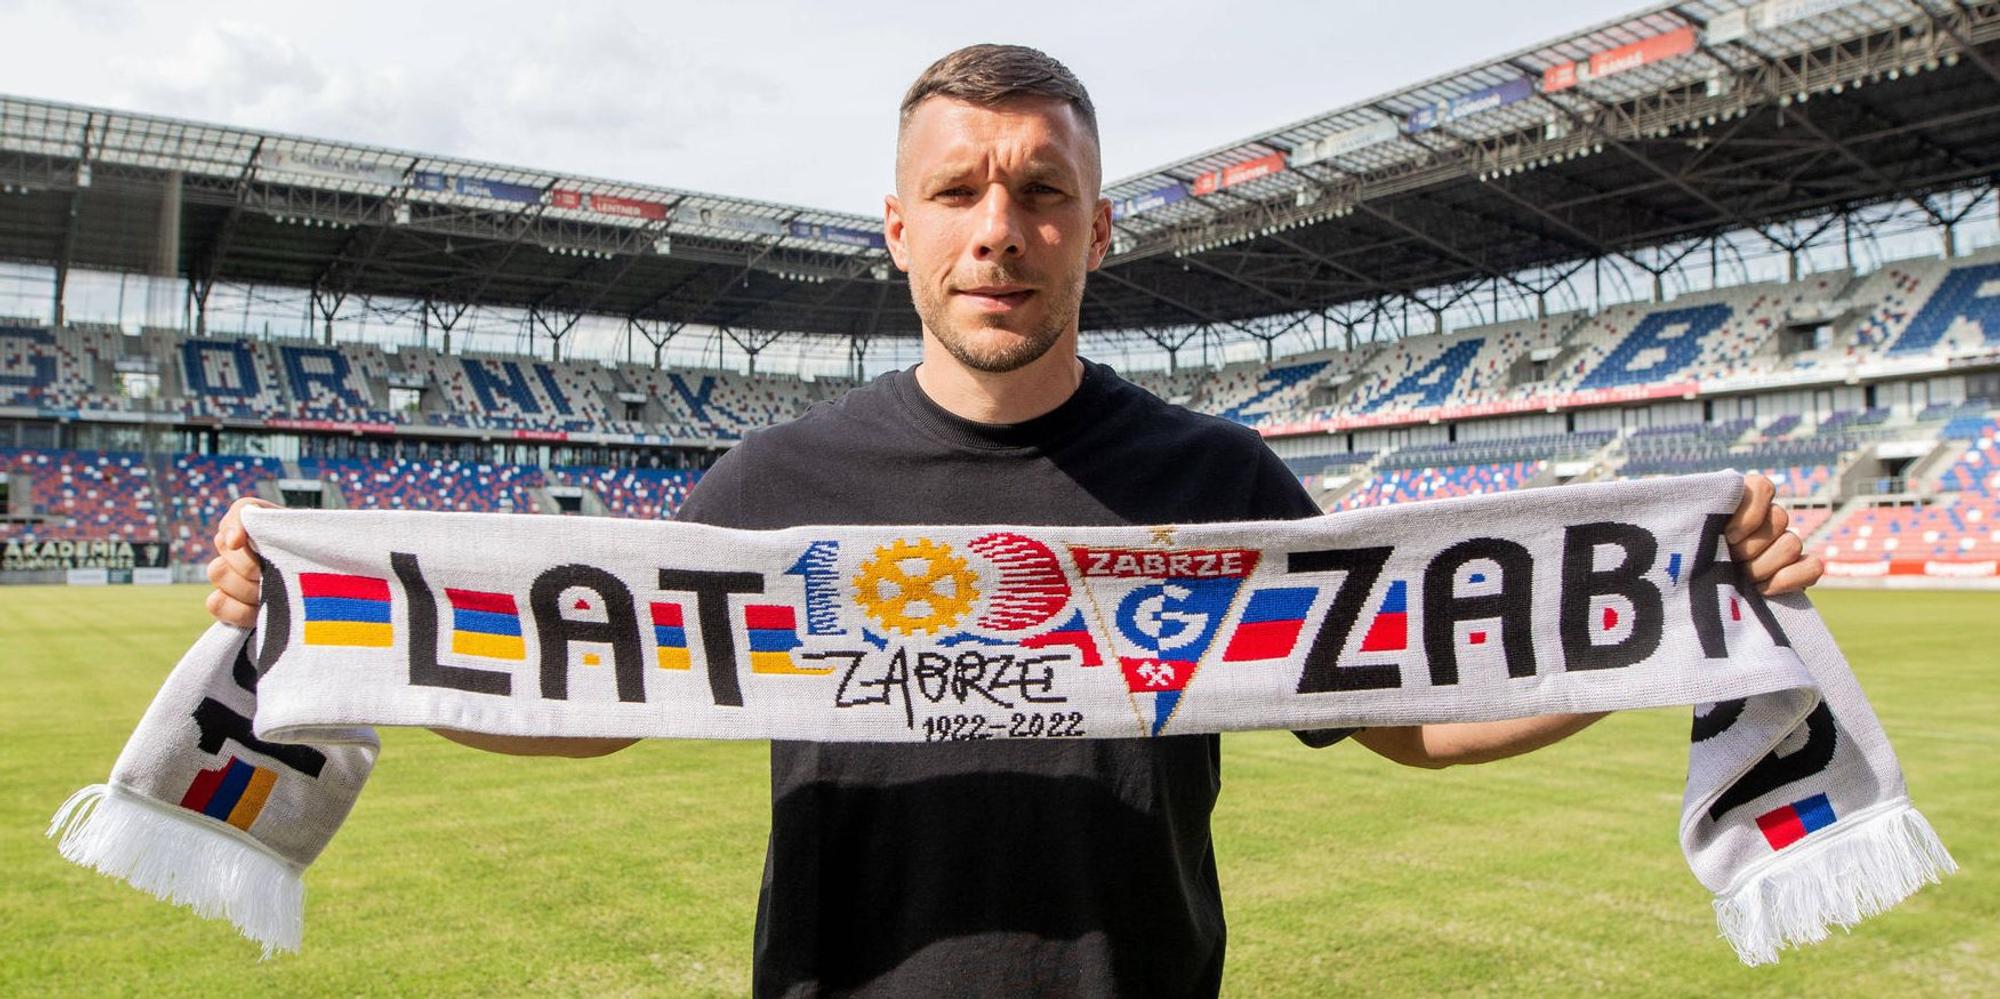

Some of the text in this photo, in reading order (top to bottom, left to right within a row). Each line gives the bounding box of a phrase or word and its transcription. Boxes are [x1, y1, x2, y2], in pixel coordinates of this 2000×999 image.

[4, 540, 135, 560] AKADEMIA
[1086, 552, 1242, 577] ZABRZE
[390, 551, 765, 706] LAT
[803, 645, 1071, 730] ZABRZE
[922, 711, 1087, 743] 1922-2022
